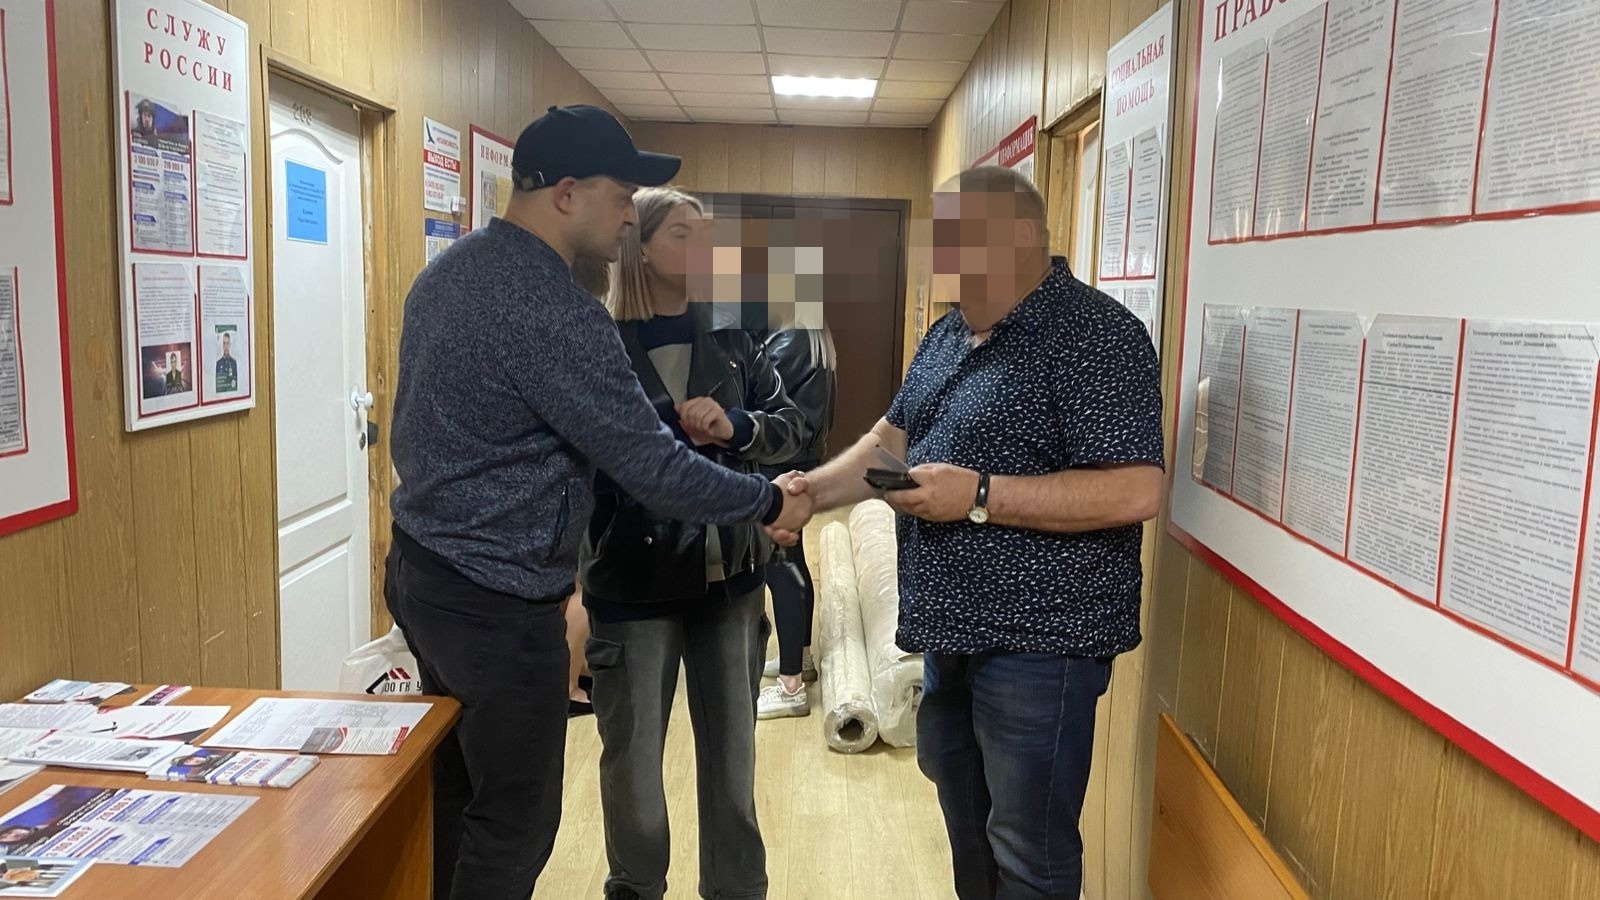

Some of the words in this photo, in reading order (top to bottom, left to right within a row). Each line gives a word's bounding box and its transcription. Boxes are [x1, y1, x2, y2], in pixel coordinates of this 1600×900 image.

[147, 8, 226, 56] СЛУЖУ
[1214, 0, 1287, 42] ПРА
[144, 41, 232, 92] РОССИИ
[1111, 34, 1165, 89] СОЦИАЛЬНАЯ
[1116, 78, 1155, 117] ПОМОЩЬ
[481, 144, 513, 169] ИНФОРМ
